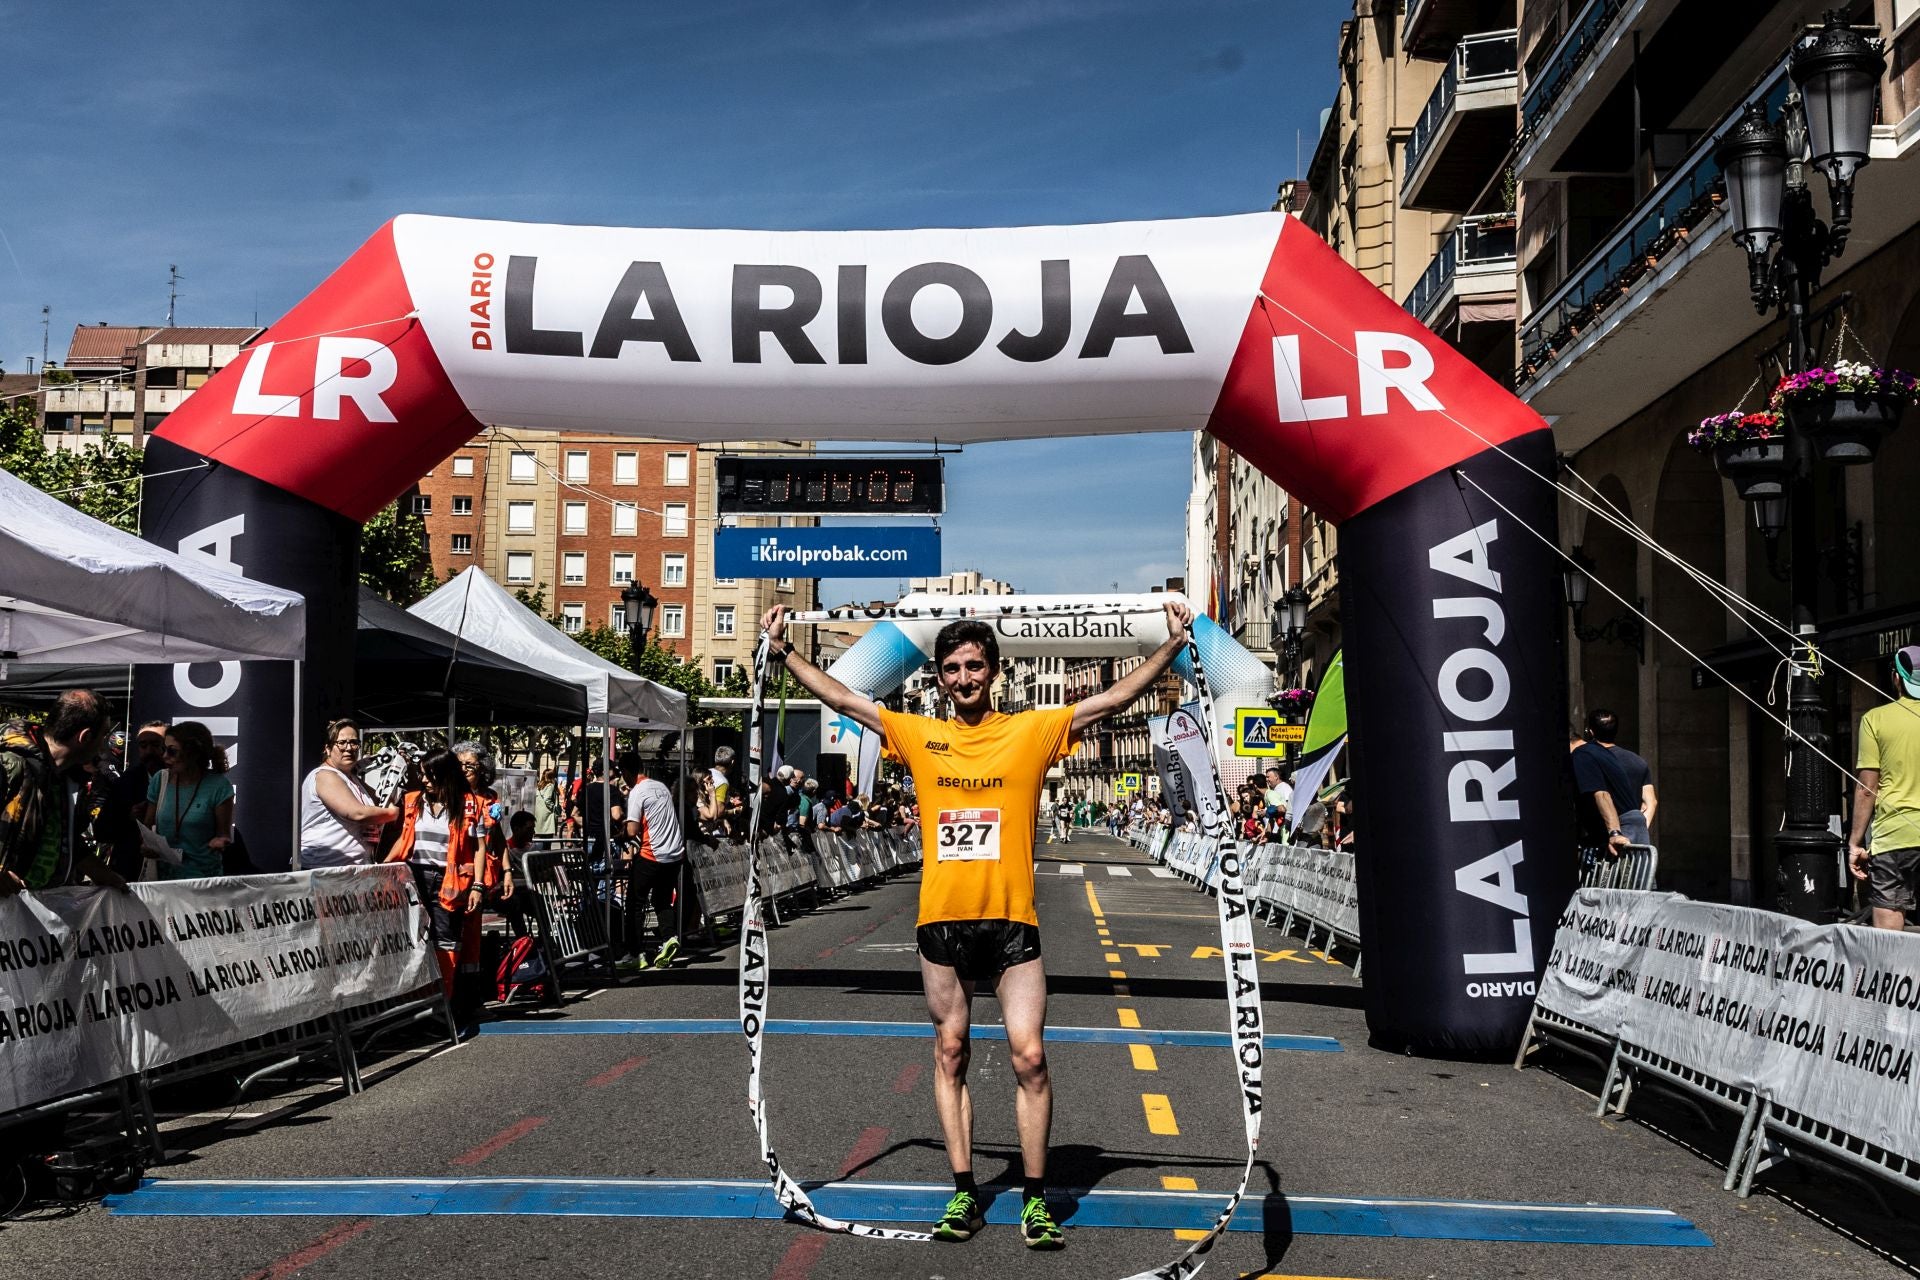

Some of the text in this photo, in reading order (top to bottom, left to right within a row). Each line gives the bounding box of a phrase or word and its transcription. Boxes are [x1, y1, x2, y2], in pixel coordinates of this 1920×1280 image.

[471, 252, 494, 351] DIARIO
[505, 254, 1195, 366] LA RIOJA
[231, 336, 399, 424] LR
[1272, 330, 1446, 423] LR
[760, 545, 908, 566] Kirolprobak.com
[996, 615, 1135, 638] CaixaBank
[937, 776, 1003, 788] asenrun
[1428, 518, 1535, 974] LA RIOJA
[940, 824, 993, 847] 327
[0, 934, 65, 972] RIOJA
[101, 919, 164, 956] RIOJA
[196, 909, 244, 937] RIOJA
[272, 898, 317, 925] RIOJA
[745, 929, 765, 972] LA
[1674, 929, 1706, 960] RIOJA
[1730, 943, 1769, 976] RIOJA
[1792, 955, 1845, 993] RIOJA
[1878, 972, 1920, 1012] RIOJ
[15, 998, 78, 1038] RIOJA
[116, 976, 181, 1014] RIOJA
[215, 960, 264, 990] RIOJA
[288, 945, 330, 974] RIOJA
[1466, 981, 1535, 998] DIARIO
[1231, 953, 1262, 1116] LA RIOJA
[1659, 981, 1692, 1012] RIOJA
[1713, 997, 1752, 1032] RIOJA
[1773, 1014, 1826, 1056] RIOJA
[1859, 1038, 1913, 1084] RIOJA
